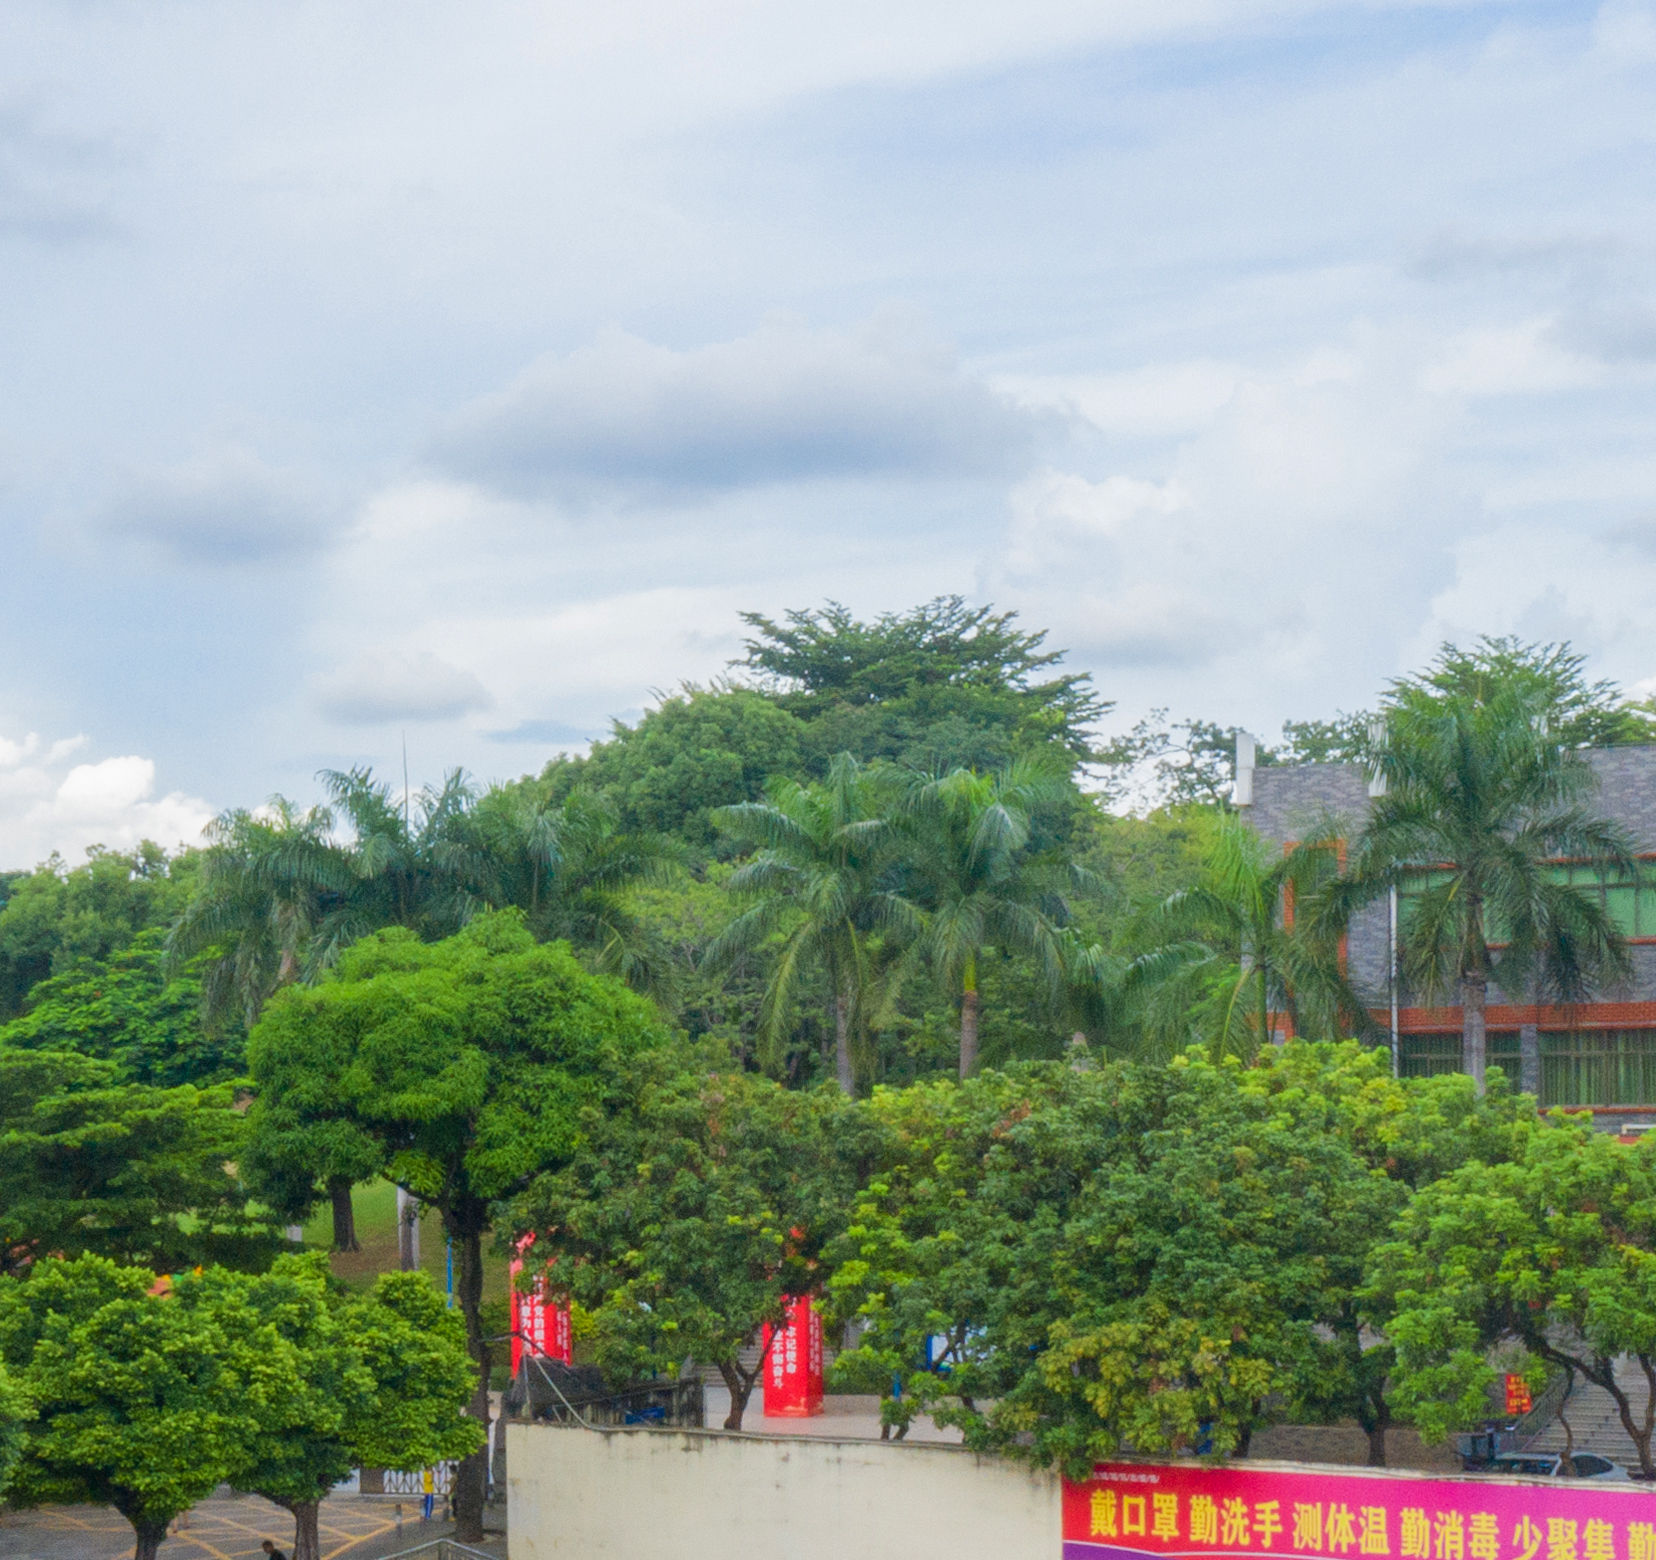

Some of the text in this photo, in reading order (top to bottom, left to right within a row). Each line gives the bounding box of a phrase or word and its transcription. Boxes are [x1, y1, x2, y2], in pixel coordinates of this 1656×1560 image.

[1090, 1488, 1178, 1541] 戴口罩
[1190, 1496, 1282, 1547] 勤洗手
[1293, 1502, 1390, 1554] 测体温
